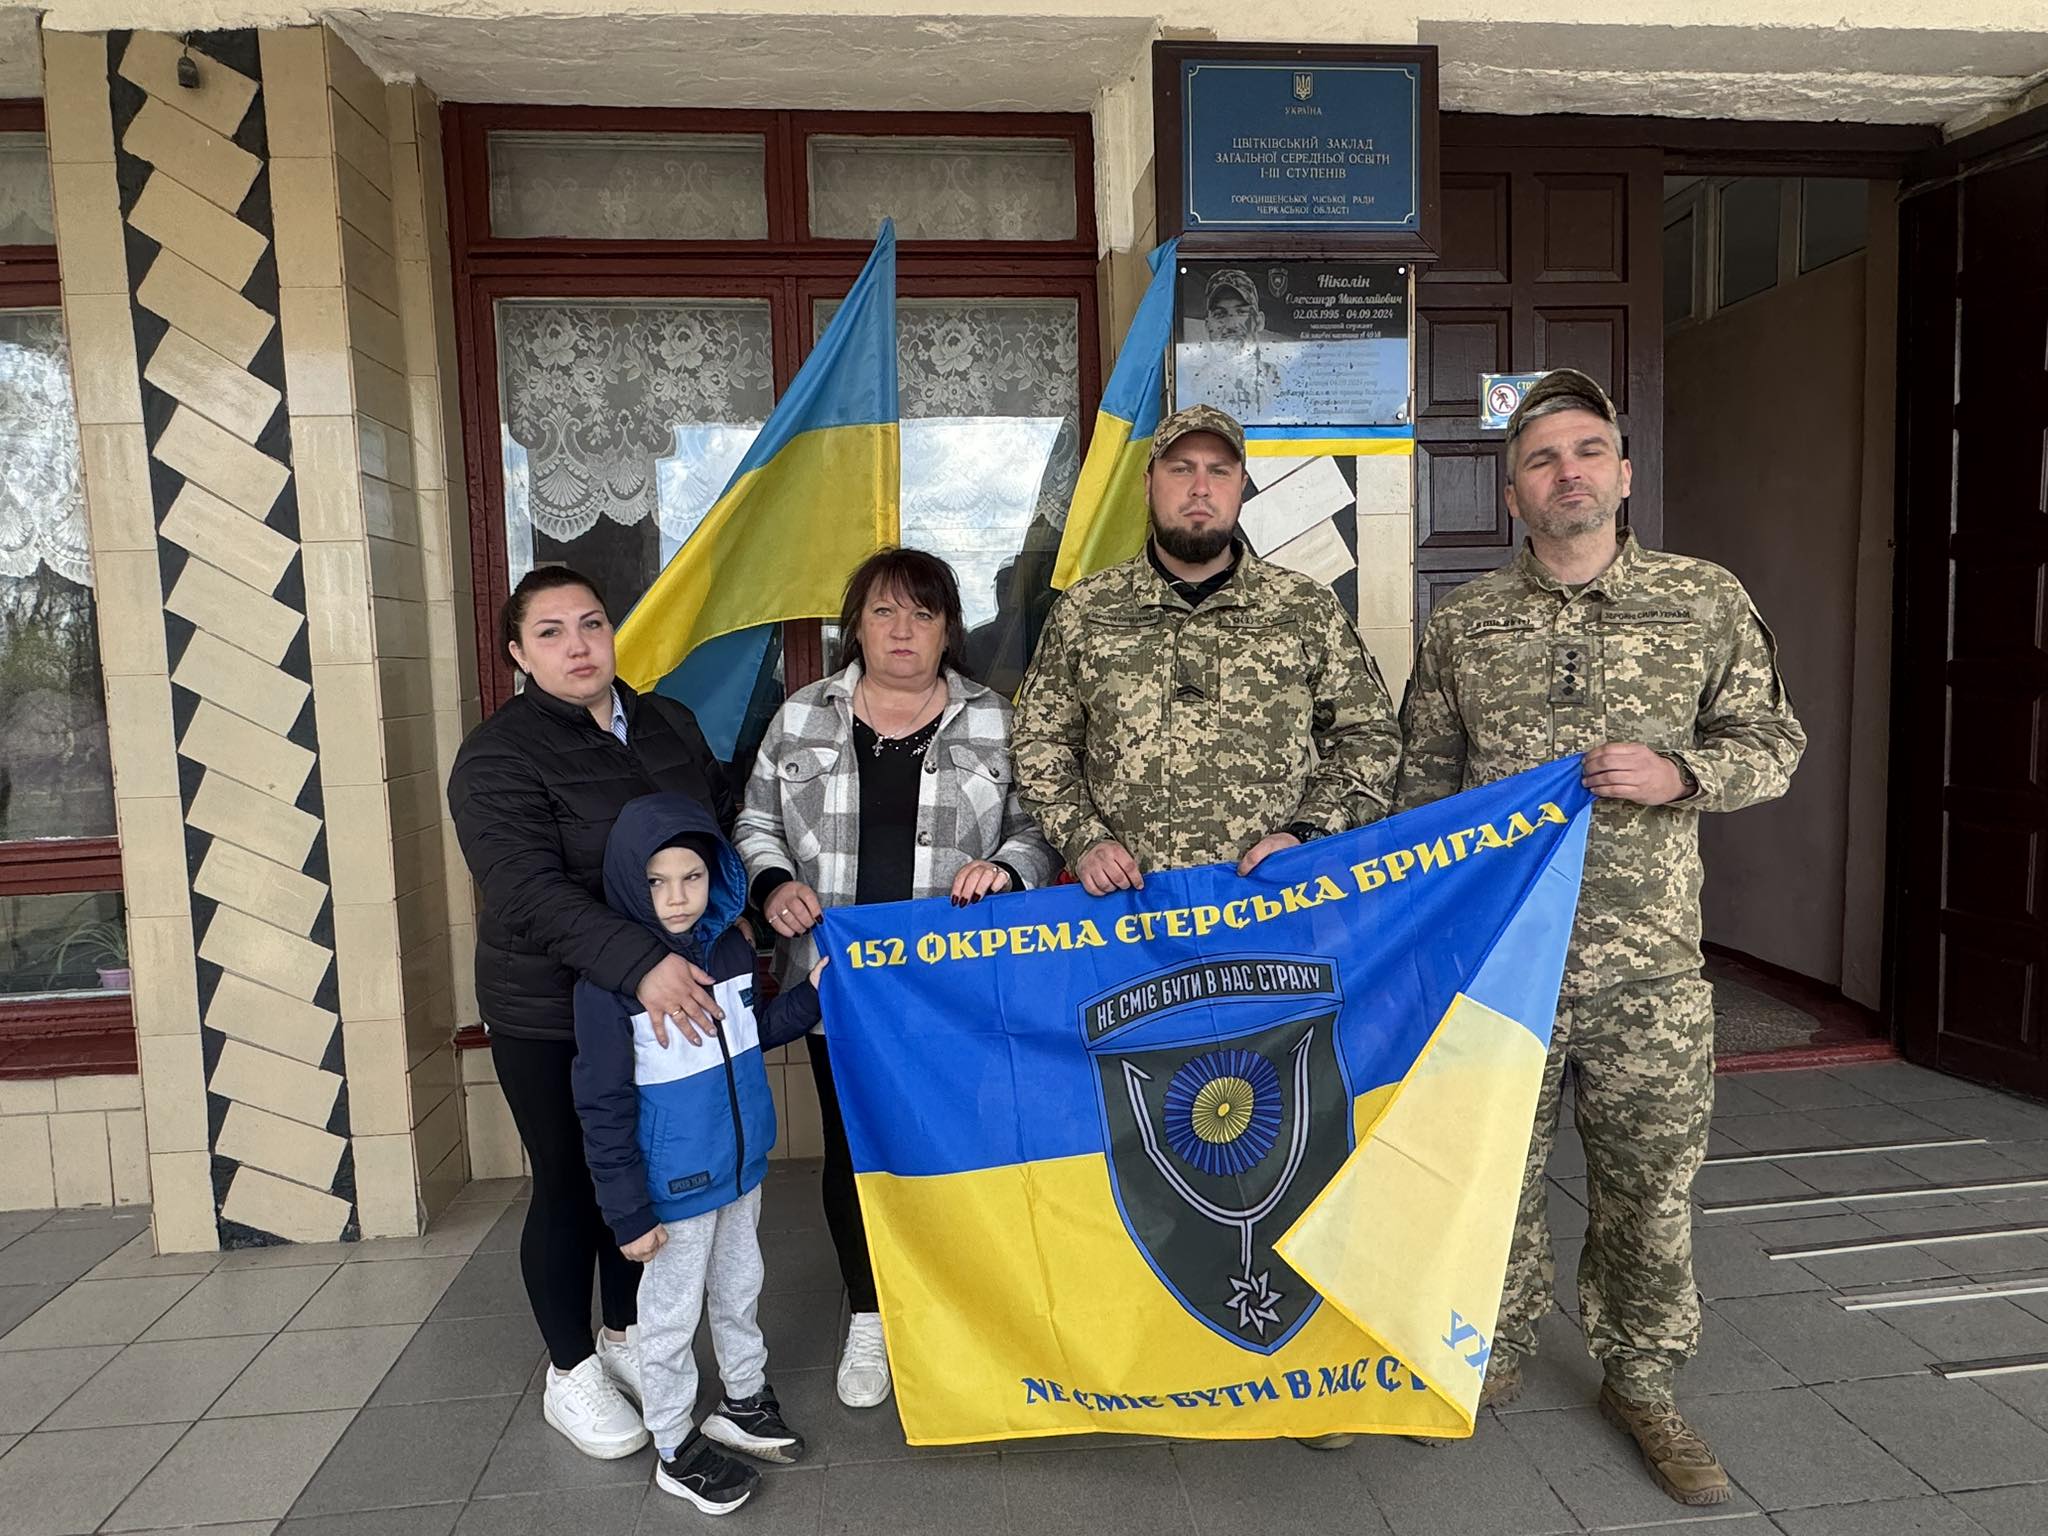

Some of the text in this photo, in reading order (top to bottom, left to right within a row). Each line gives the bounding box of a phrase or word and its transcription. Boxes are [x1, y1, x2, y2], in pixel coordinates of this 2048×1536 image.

[1284, 106, 1322, 116] УКРАЇНА
[1233, 136, 1373, 150] ЦВІТКІВСЬКИЙ ЗАКЛАД
[1215, 151, 1390, 165] ЗАГАЛЬНОЇ СЕРЕДНЬОЇ ОСВІТИ
[1286, 168, 1347, 179] СТУПЕНІВ
[1231, 194, 1375, 205] ГОРОДИЩЕНСЬКОЇ МІСЬКОЇ РАДИ
[1257, 206, 1350, 215] ЧЕРКАСЬКОЇ ОБЛАСТІ
[1317, 274, 1370, 288] Ніколін
[1346, 309, 1393, 319] 04.09.2024
[847, 801, 1568, 969] 152 ОКРЕМА ЄГЕРСЬКА БРИГАДА
[1096, 964, 1320, 1032] НЕ СМІЄ БУТИ В НАС СТРАХУ
[1072, 1388, 1164, 1412] СМІЄ
[1167, 1375, 1280, 1408] БУТИ
[1282, 1368, 1312, 1399] В
